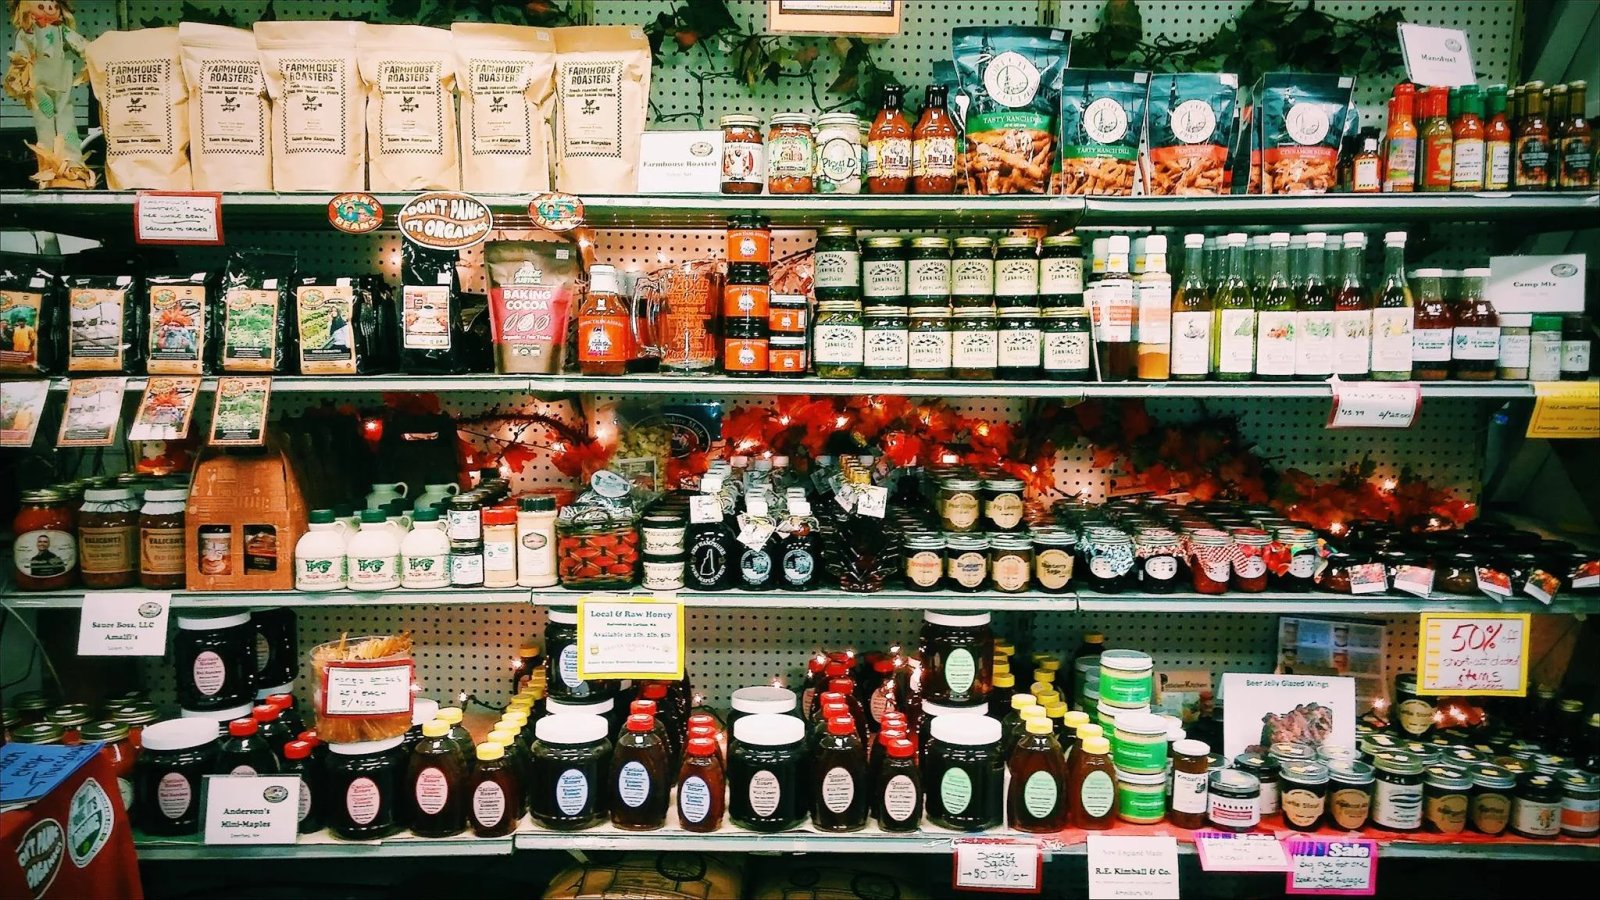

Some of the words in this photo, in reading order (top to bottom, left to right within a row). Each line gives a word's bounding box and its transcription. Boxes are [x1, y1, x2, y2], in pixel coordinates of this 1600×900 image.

[112, 64, 162, 75] FARMHOUSE
[208, 65, 259, 76] FARMHOUSE
[286, 64, 337, 72] FARMHOUSE
[385, 65, 434, 74] FARMHOUSE
[476, 64, 524, 74] FARMHOUSE
[568, 66, 615, 75] FARMHOUSE
[116, 73, 158, 84] ROASTERS
[210, 73, 254, 84] ROASTERS
[290, 72, 333, 82] ROASTERS
[388, 74, 430, 82] ROASTERS
[571, 75, 611, 85] ROASTERS
[333, 194, 378, 211] DEAN'S
[406, 198, 448, 216] DON'T
[450, 199, 485, 220] PANIC
[335, 216, 379, 230] BEANS
[405, 220, 423, 232] IT'S
[503, 289, 552, 300] BAKING
[505, 300, 548, 310] COCOA
[698, 540, 726, 556] HAMPSHIRE
[1451, 623, 1502, 652] 50%
[1459, 668, 1502, 682] items
[1329, 842, 1369, 858] Sale
